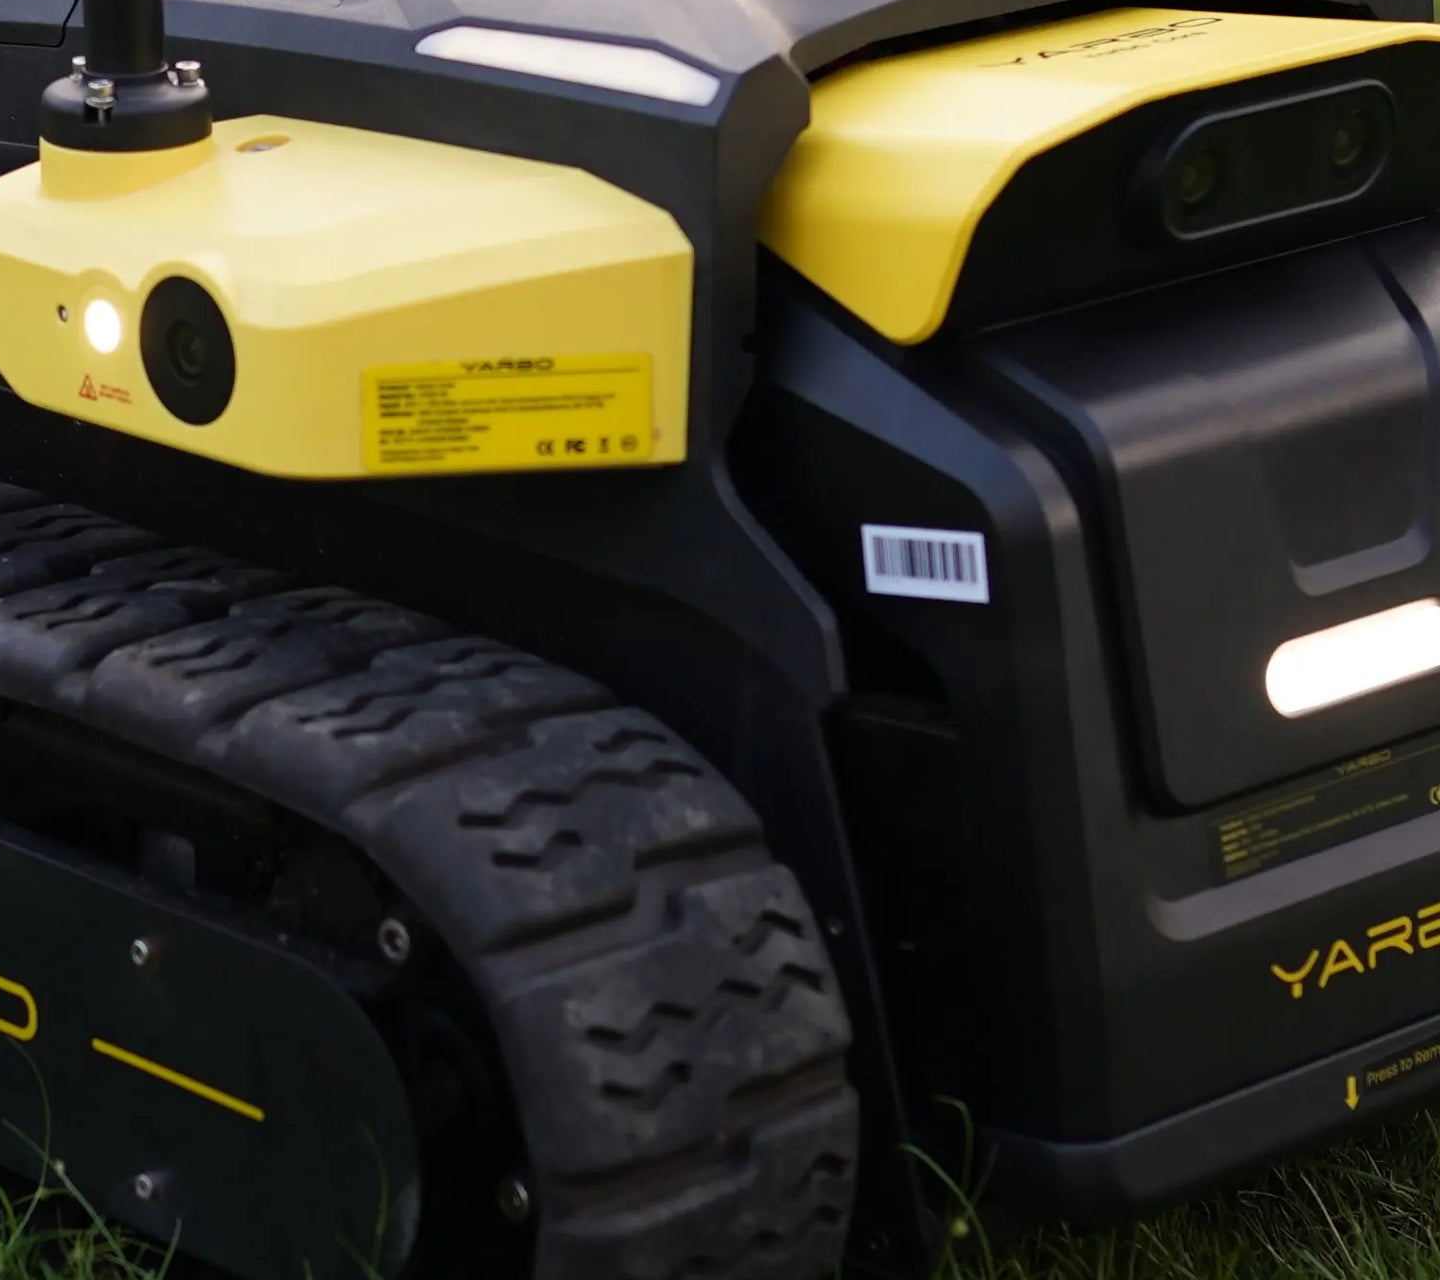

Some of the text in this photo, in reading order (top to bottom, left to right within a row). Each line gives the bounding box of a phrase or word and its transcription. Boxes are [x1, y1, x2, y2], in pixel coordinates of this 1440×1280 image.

[977, 17, 1223, 69] YARBO
[460, 357, 555, 371] YARBO
[1334, 749, 1392, 776] YARBO
[1366, 1063, 1399, 1086] Press
[1399, 1057, 1413, 1072] To
